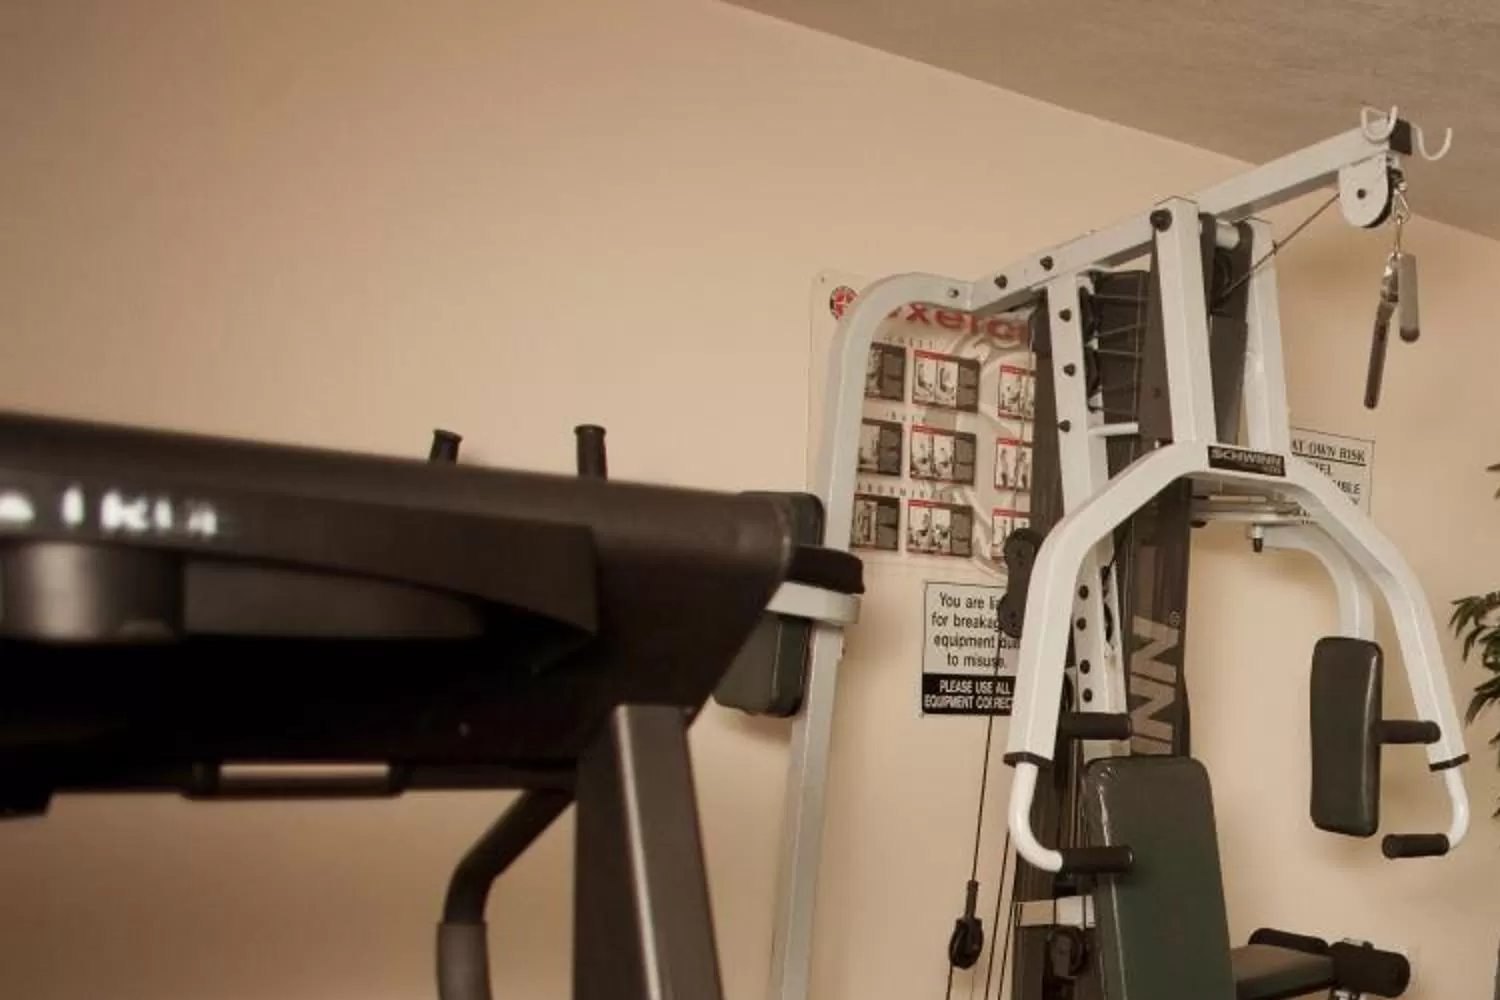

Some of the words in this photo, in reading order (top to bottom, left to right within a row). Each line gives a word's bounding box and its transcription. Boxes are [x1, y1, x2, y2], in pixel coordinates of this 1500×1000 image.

[1211, 448, 1281, 468] SCHWINN
[1308, 441, 1336, 457] OWN
[1339, 447, 1366, 462] RISK
[939, 592, 961, 608] You
[966, 596, 985, 609] are
[931, 612, 949, 627] for
[953, 613, 1002, 632] breakag
[933, 633, 995, 650] equipment
[947, 652, 959, 667] to
[939, 680, 973, 694] PLEASE
[975, 681, 993, 695] USE
[995, 682, 1011, 695] ALL
[924, 694, 974, 709] EQUIPMENT
